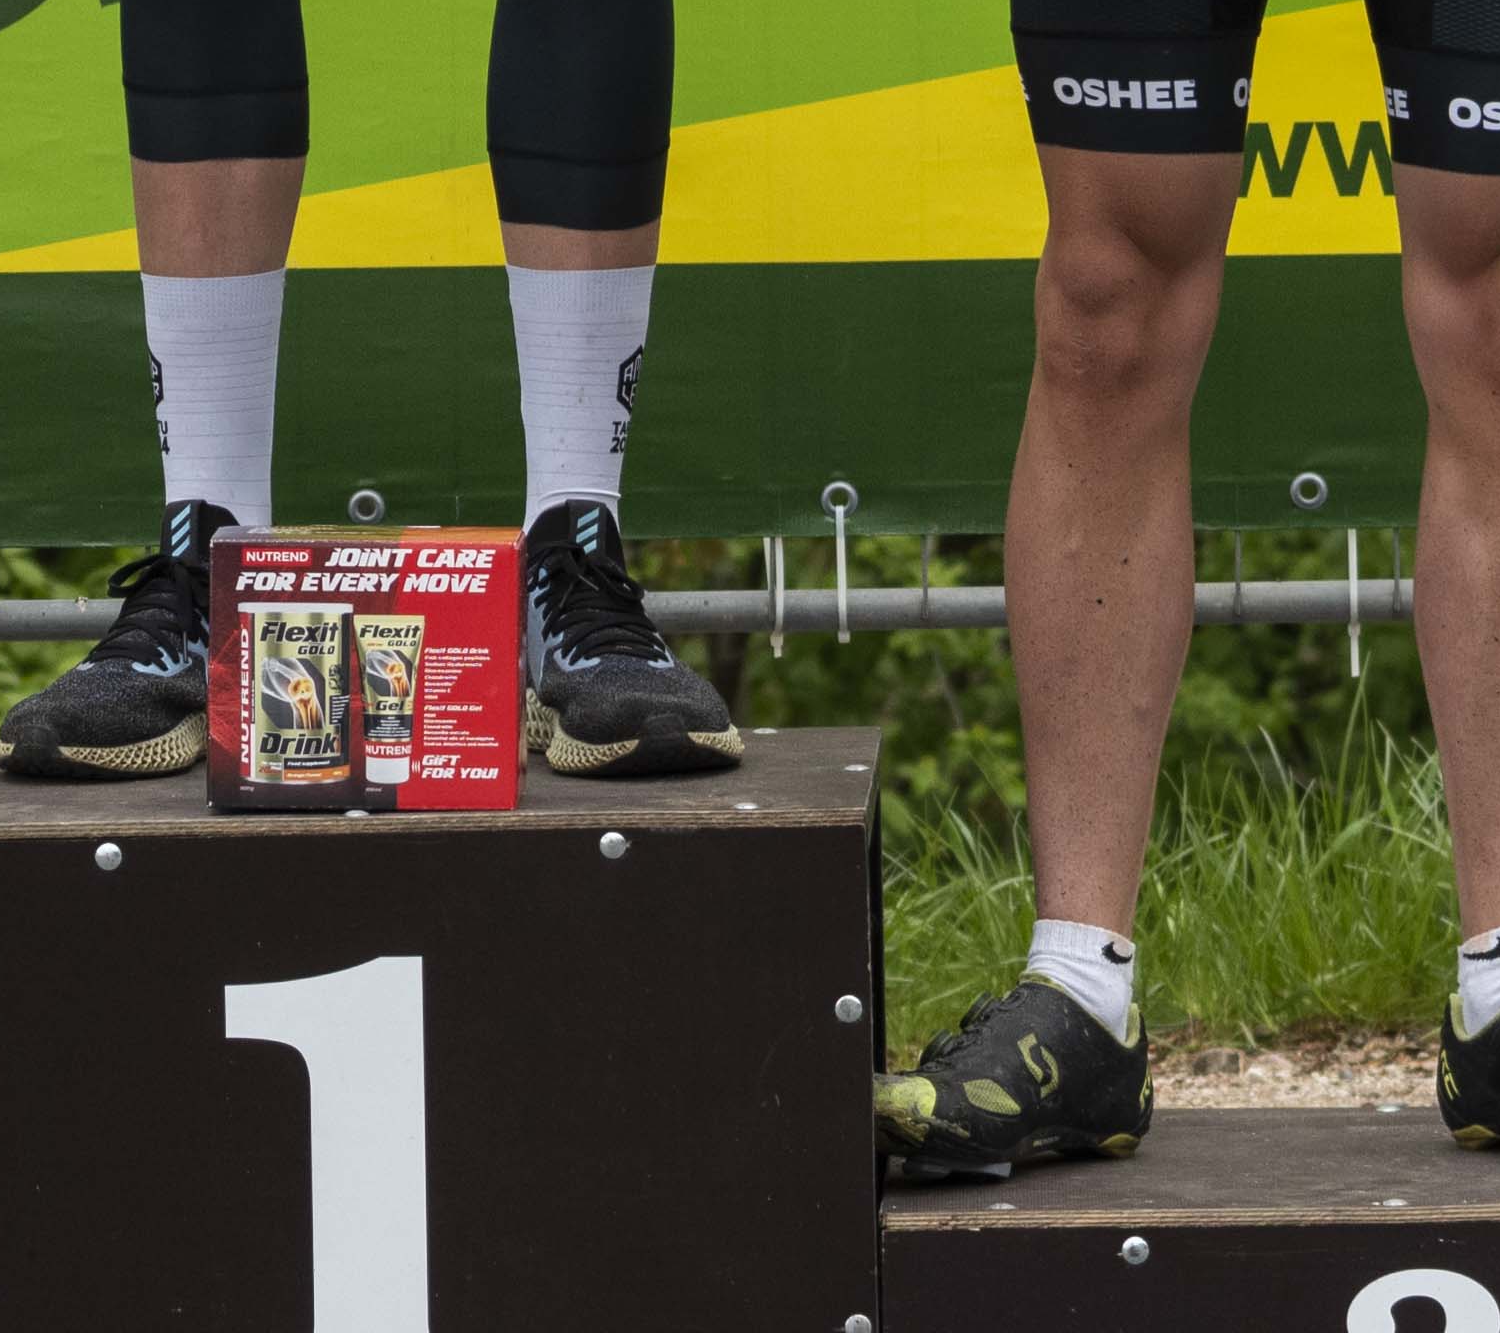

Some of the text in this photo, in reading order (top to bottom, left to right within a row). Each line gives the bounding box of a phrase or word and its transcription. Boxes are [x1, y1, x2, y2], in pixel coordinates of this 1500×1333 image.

[1052, 76, 1199, 111] OSHEE
[245, 547, 497, 569] NUTREND JOINT CARE
[235, 571, 490, 594] FOR EVERY MOVE
[259, 621, 340, 643] Flexit
[359, 624, 421, 639] Flexit
[297, 644, 336, 656] GOLD
[387, 639, 417, 647] GOLD
[240, 628, 250, 764] NUTREND
[375, 700, 405, 712] Gel
[259, 732, 338, 756] Drink
[421, 754, 461, 767] GIFT
[421, 767, 456, 780] FOR
[225, 953, 432, 1333] 1
